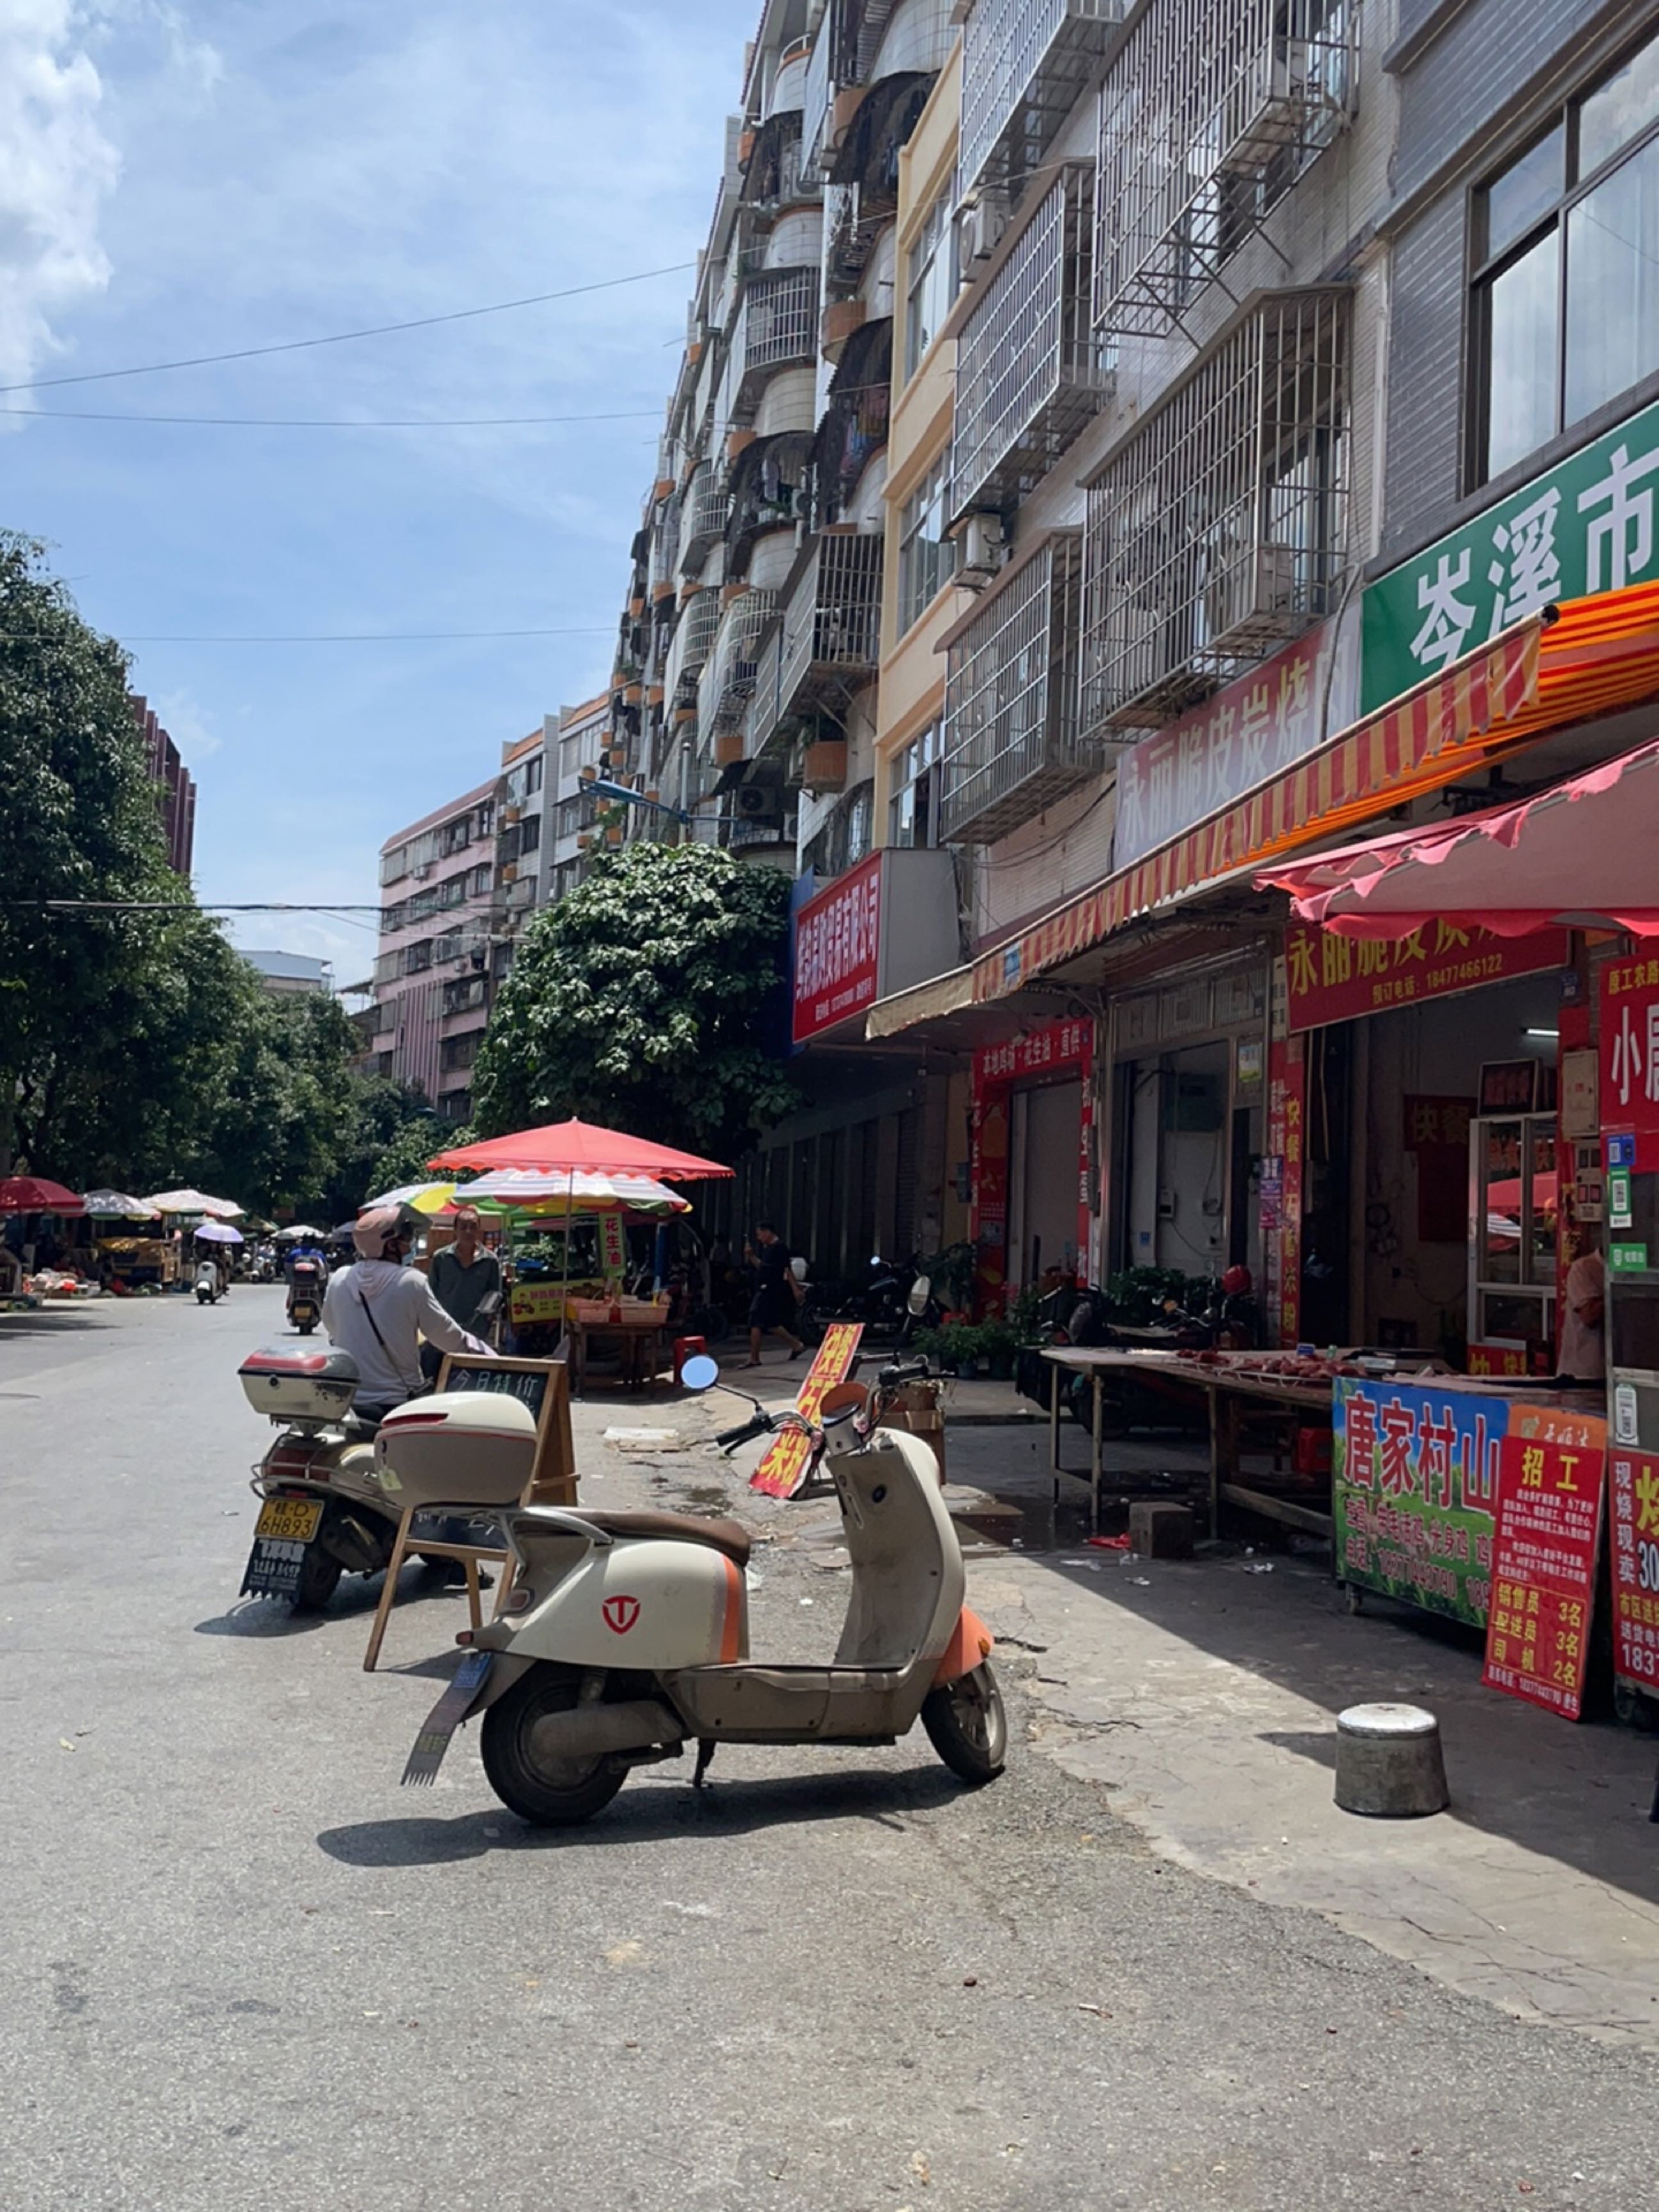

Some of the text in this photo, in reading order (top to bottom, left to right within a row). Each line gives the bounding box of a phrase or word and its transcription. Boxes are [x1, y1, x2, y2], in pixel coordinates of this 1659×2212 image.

[1410, 442, 1659, 671] 岑溪市
[605, 1217, 623, 1265] 花生油
[453, 1368, 539, 1398] 今日特价
[1345, 1390, 1499, 1520] 唐家村山
[1521, 1445, 1579, 1491] 招工
[261, 1516, 313, 1535] 6H893
[1558, 1601, 1582, 1628] 3名
[1556, 1630, 1579, 1658] 3名
[1620, 1620, 1659, 1649] 送货电
[1553, 1660, 1576, 1688] 2名
